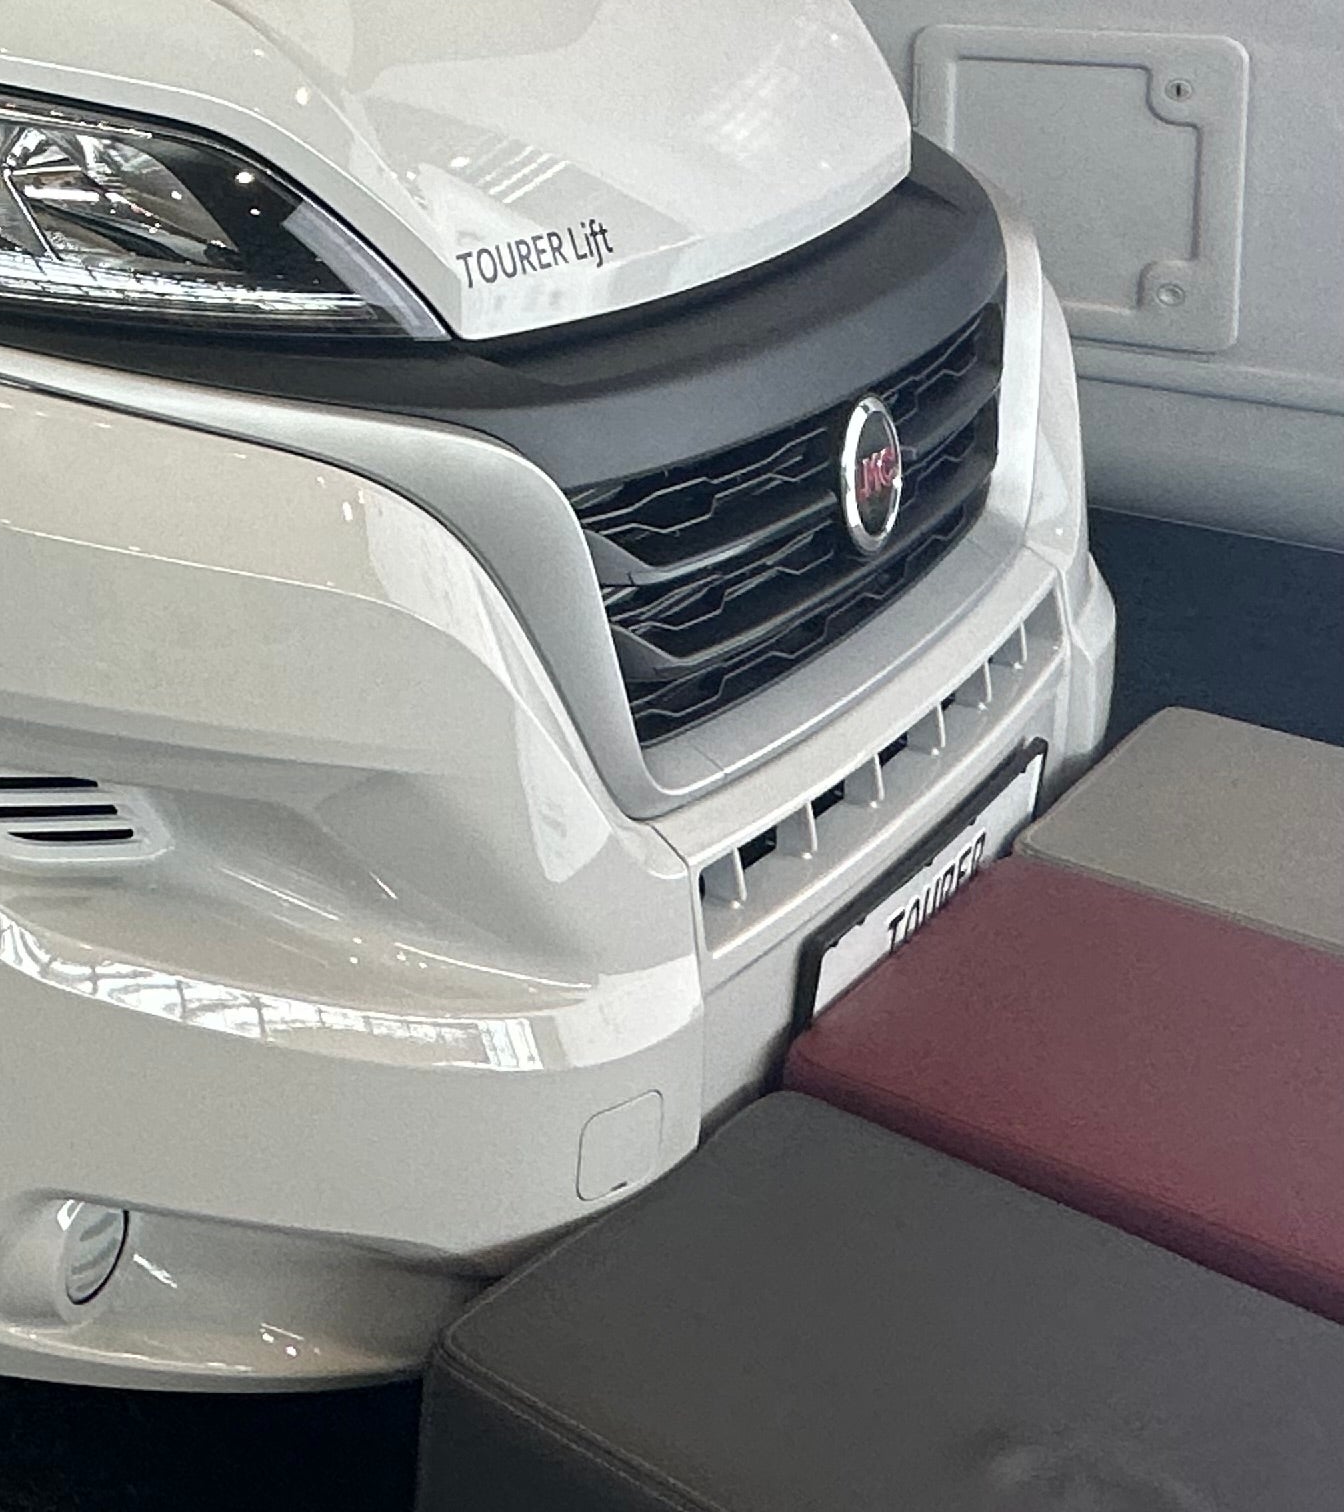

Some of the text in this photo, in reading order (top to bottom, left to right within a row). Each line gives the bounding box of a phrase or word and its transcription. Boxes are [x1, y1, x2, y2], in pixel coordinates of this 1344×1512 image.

[456, 219, 614, 289] TOURER Lift
[887, 830, 987, 955] TOURER
